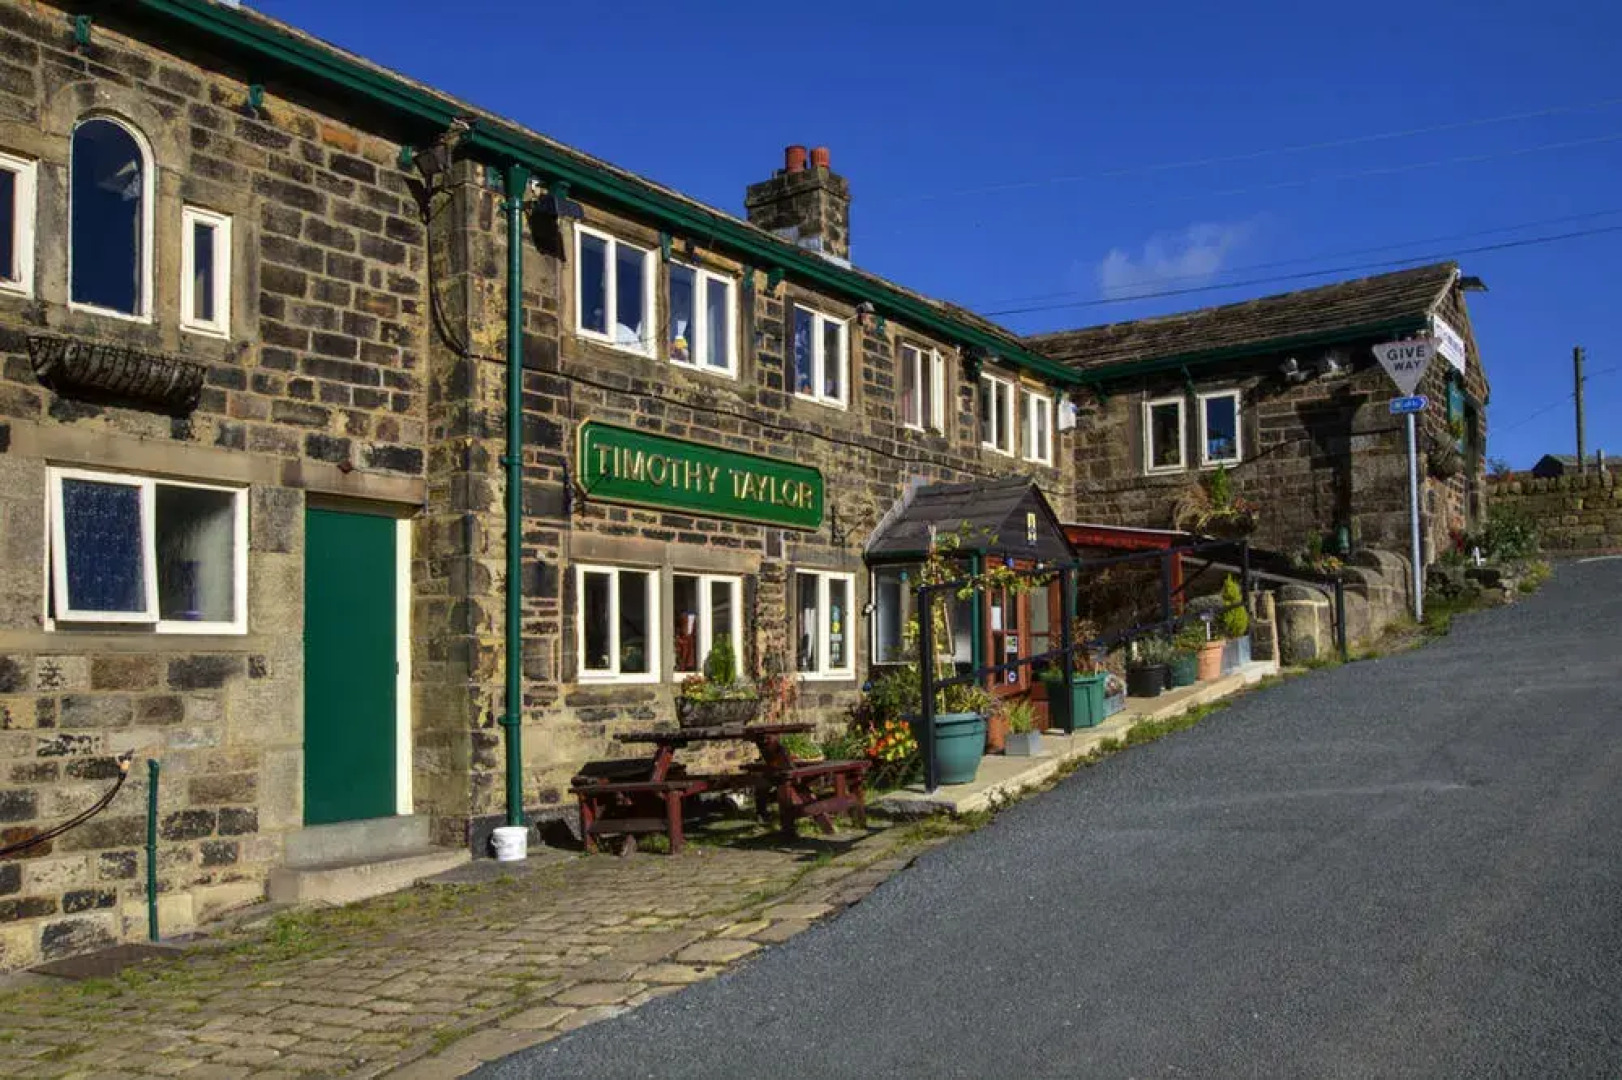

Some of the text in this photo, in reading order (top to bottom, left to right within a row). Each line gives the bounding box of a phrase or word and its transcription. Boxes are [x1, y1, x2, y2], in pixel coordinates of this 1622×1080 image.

[1387, 346, 1425, 361] GIVE
[1394, 360, 1420, 371] WAY
[593, 443, 813, 509] TIMOTHY TAYLOR
